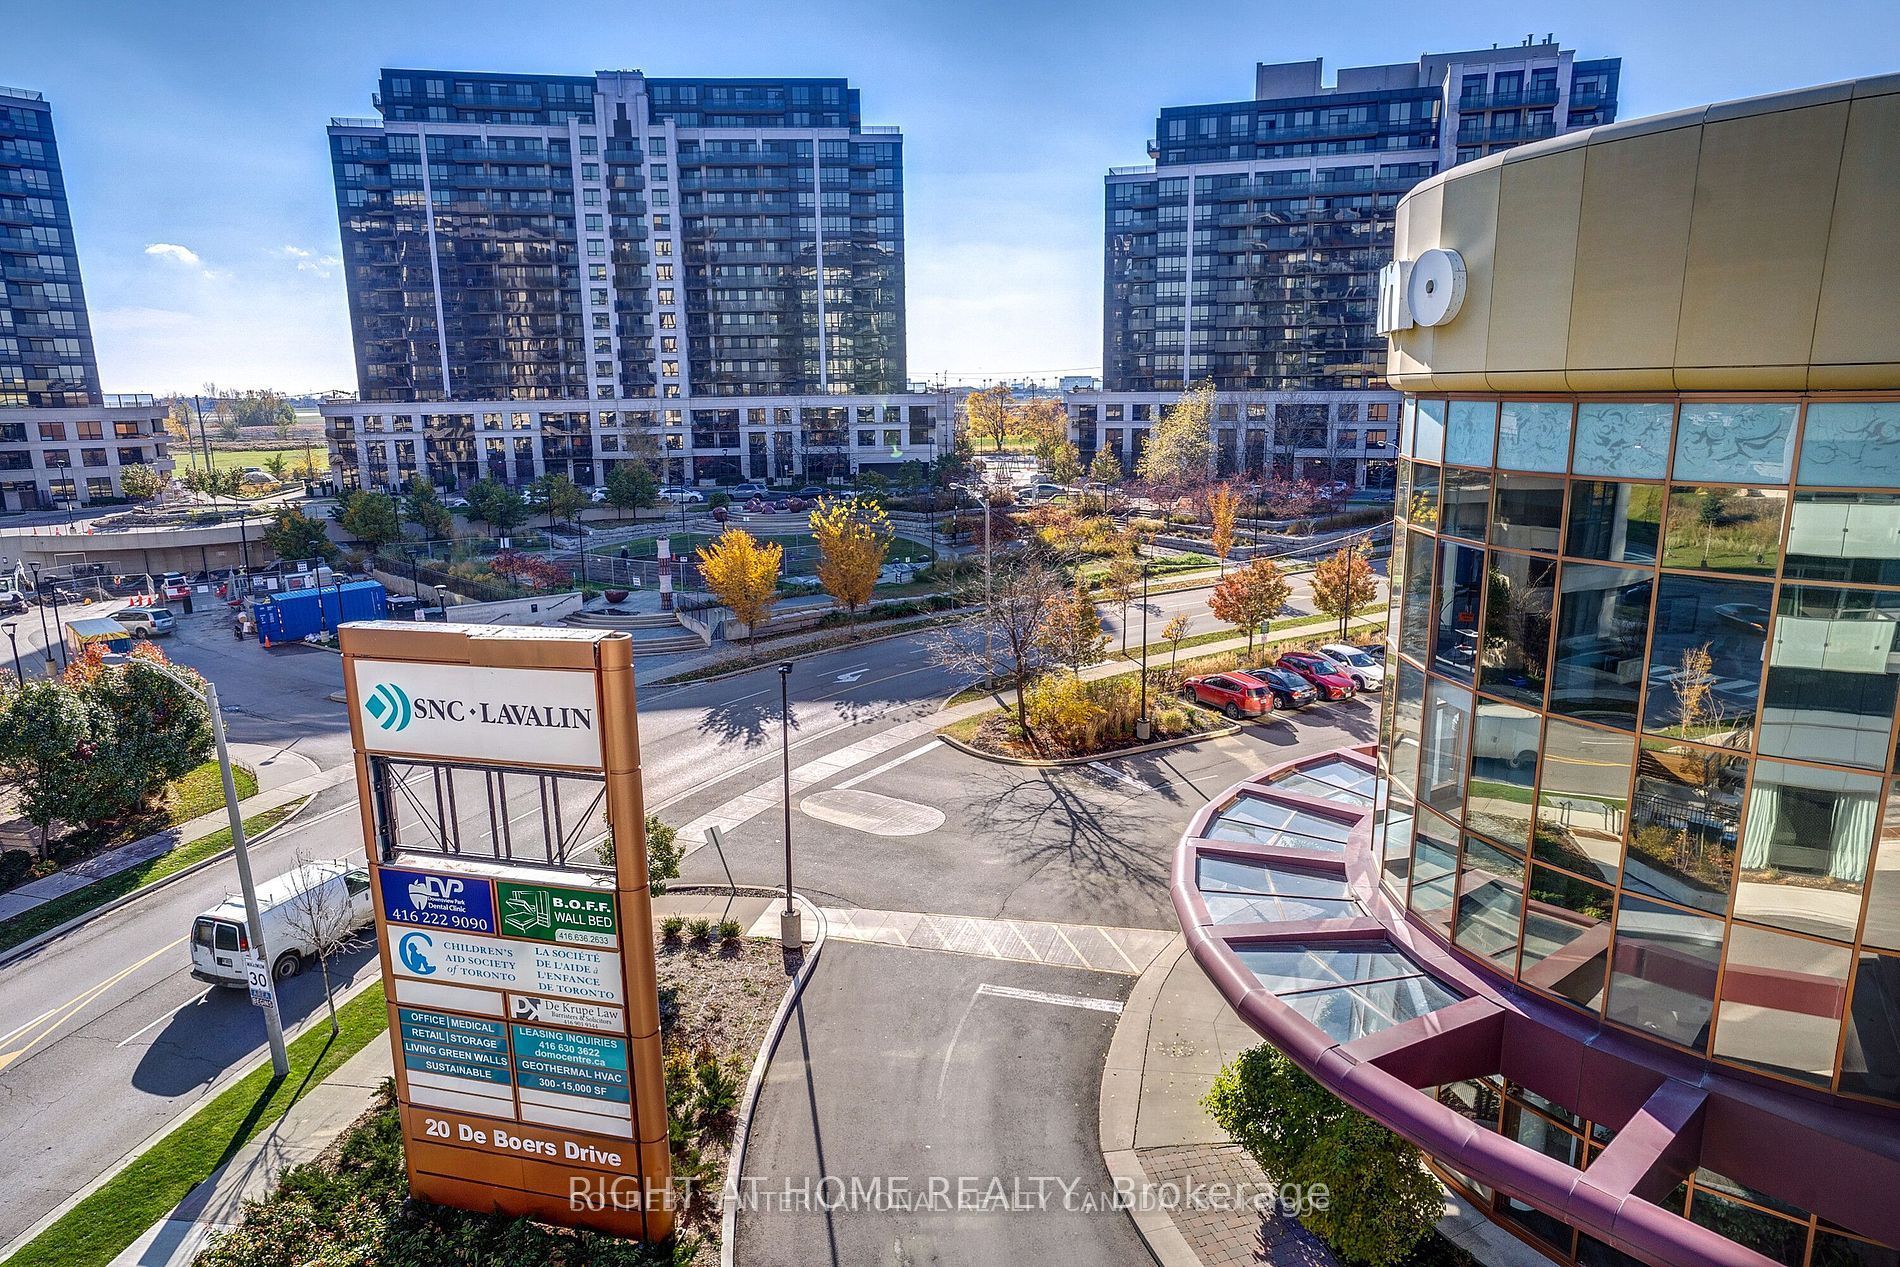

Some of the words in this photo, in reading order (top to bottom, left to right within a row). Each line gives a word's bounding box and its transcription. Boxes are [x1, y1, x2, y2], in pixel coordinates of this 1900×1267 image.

[414, 698, 465, 721] SNC
[479, 702, 592, 730] LAVALIN
[428, 902, 449, 910] Dental
[449, 904, 466, 913] Clinic
[552, 897, 611, 913] B.O.F.F.
[392, 908, 419, 922] 416
[422, 912, 448, 926] 222
[451, 915, 488, 931] 9090
[554, 911, 586, 925] WALL
[588, 915, 612, 928] BED
[558, 932, 609, 945] 416.636.2633
[443, 941, 514, 958] CHILDREN'S
[535, 947, 550, 957] LA
[552, 949, 601, 963] SOCIÉTÉ
[445, 954, 465, 963] AID
[468, 957, 516, 970] SOCIETY
[536, 959, 552, 969] DE
[554, 961, 592, 974] L'AIDE
[250, 971, 266, 987] 30
[446, 966, 459, 976] of
[460, 967, 516, 982] TORONTO
[537, 971, 600, 986] L'ENFANCE
[538, 982, 555, 993] DE
[556, 985, 615, 1000] TORONTO
[545, 1000, 560, 1012] De
[562, 1003, 594, 1018] Krupe
[597, 1008, 619, 1019] Law
[551, 1011, 579, 1022] Barristers
[585, 1016, 613, 1025] Solicitors
[411, 1012, 446, 1025] OFFICE
[451, 1018, 495, 1033] MEDICAL
[411, 1028, 445, 1041] RETAIL
[450, 1033, 498, 1049] STORAGE
[519, 1027, 564, 1041] LEASING
[566, 1034, 618, 1049] INQUIRIES
[405, 1042, 437, 1055] LIVING
[438, 1047, 472, 1061] GREEN
[473, 1053, 508, 1066] WALLS
[539, 1041, 556, 1050] 416
[558, 1044, 575, 1053] 630
[577, 1047, 600, 1057] 3622
[534, 1049, 606, 1067] domocentre.ca
[426, 1060, 493, 1079] SUSTAINABLE
[521, 1060, 593, 1079] GEOTHERMAL
[594, 1071, 622, 1083] HVAC
[594, 1087, 607, 1096] SF
[425, 1118, 451, 1138] 20
[458, 1123, 488, 1145] De
[493, 1129, 558, 1156] Boers
[564, 1141, 622, 1167] Drive
